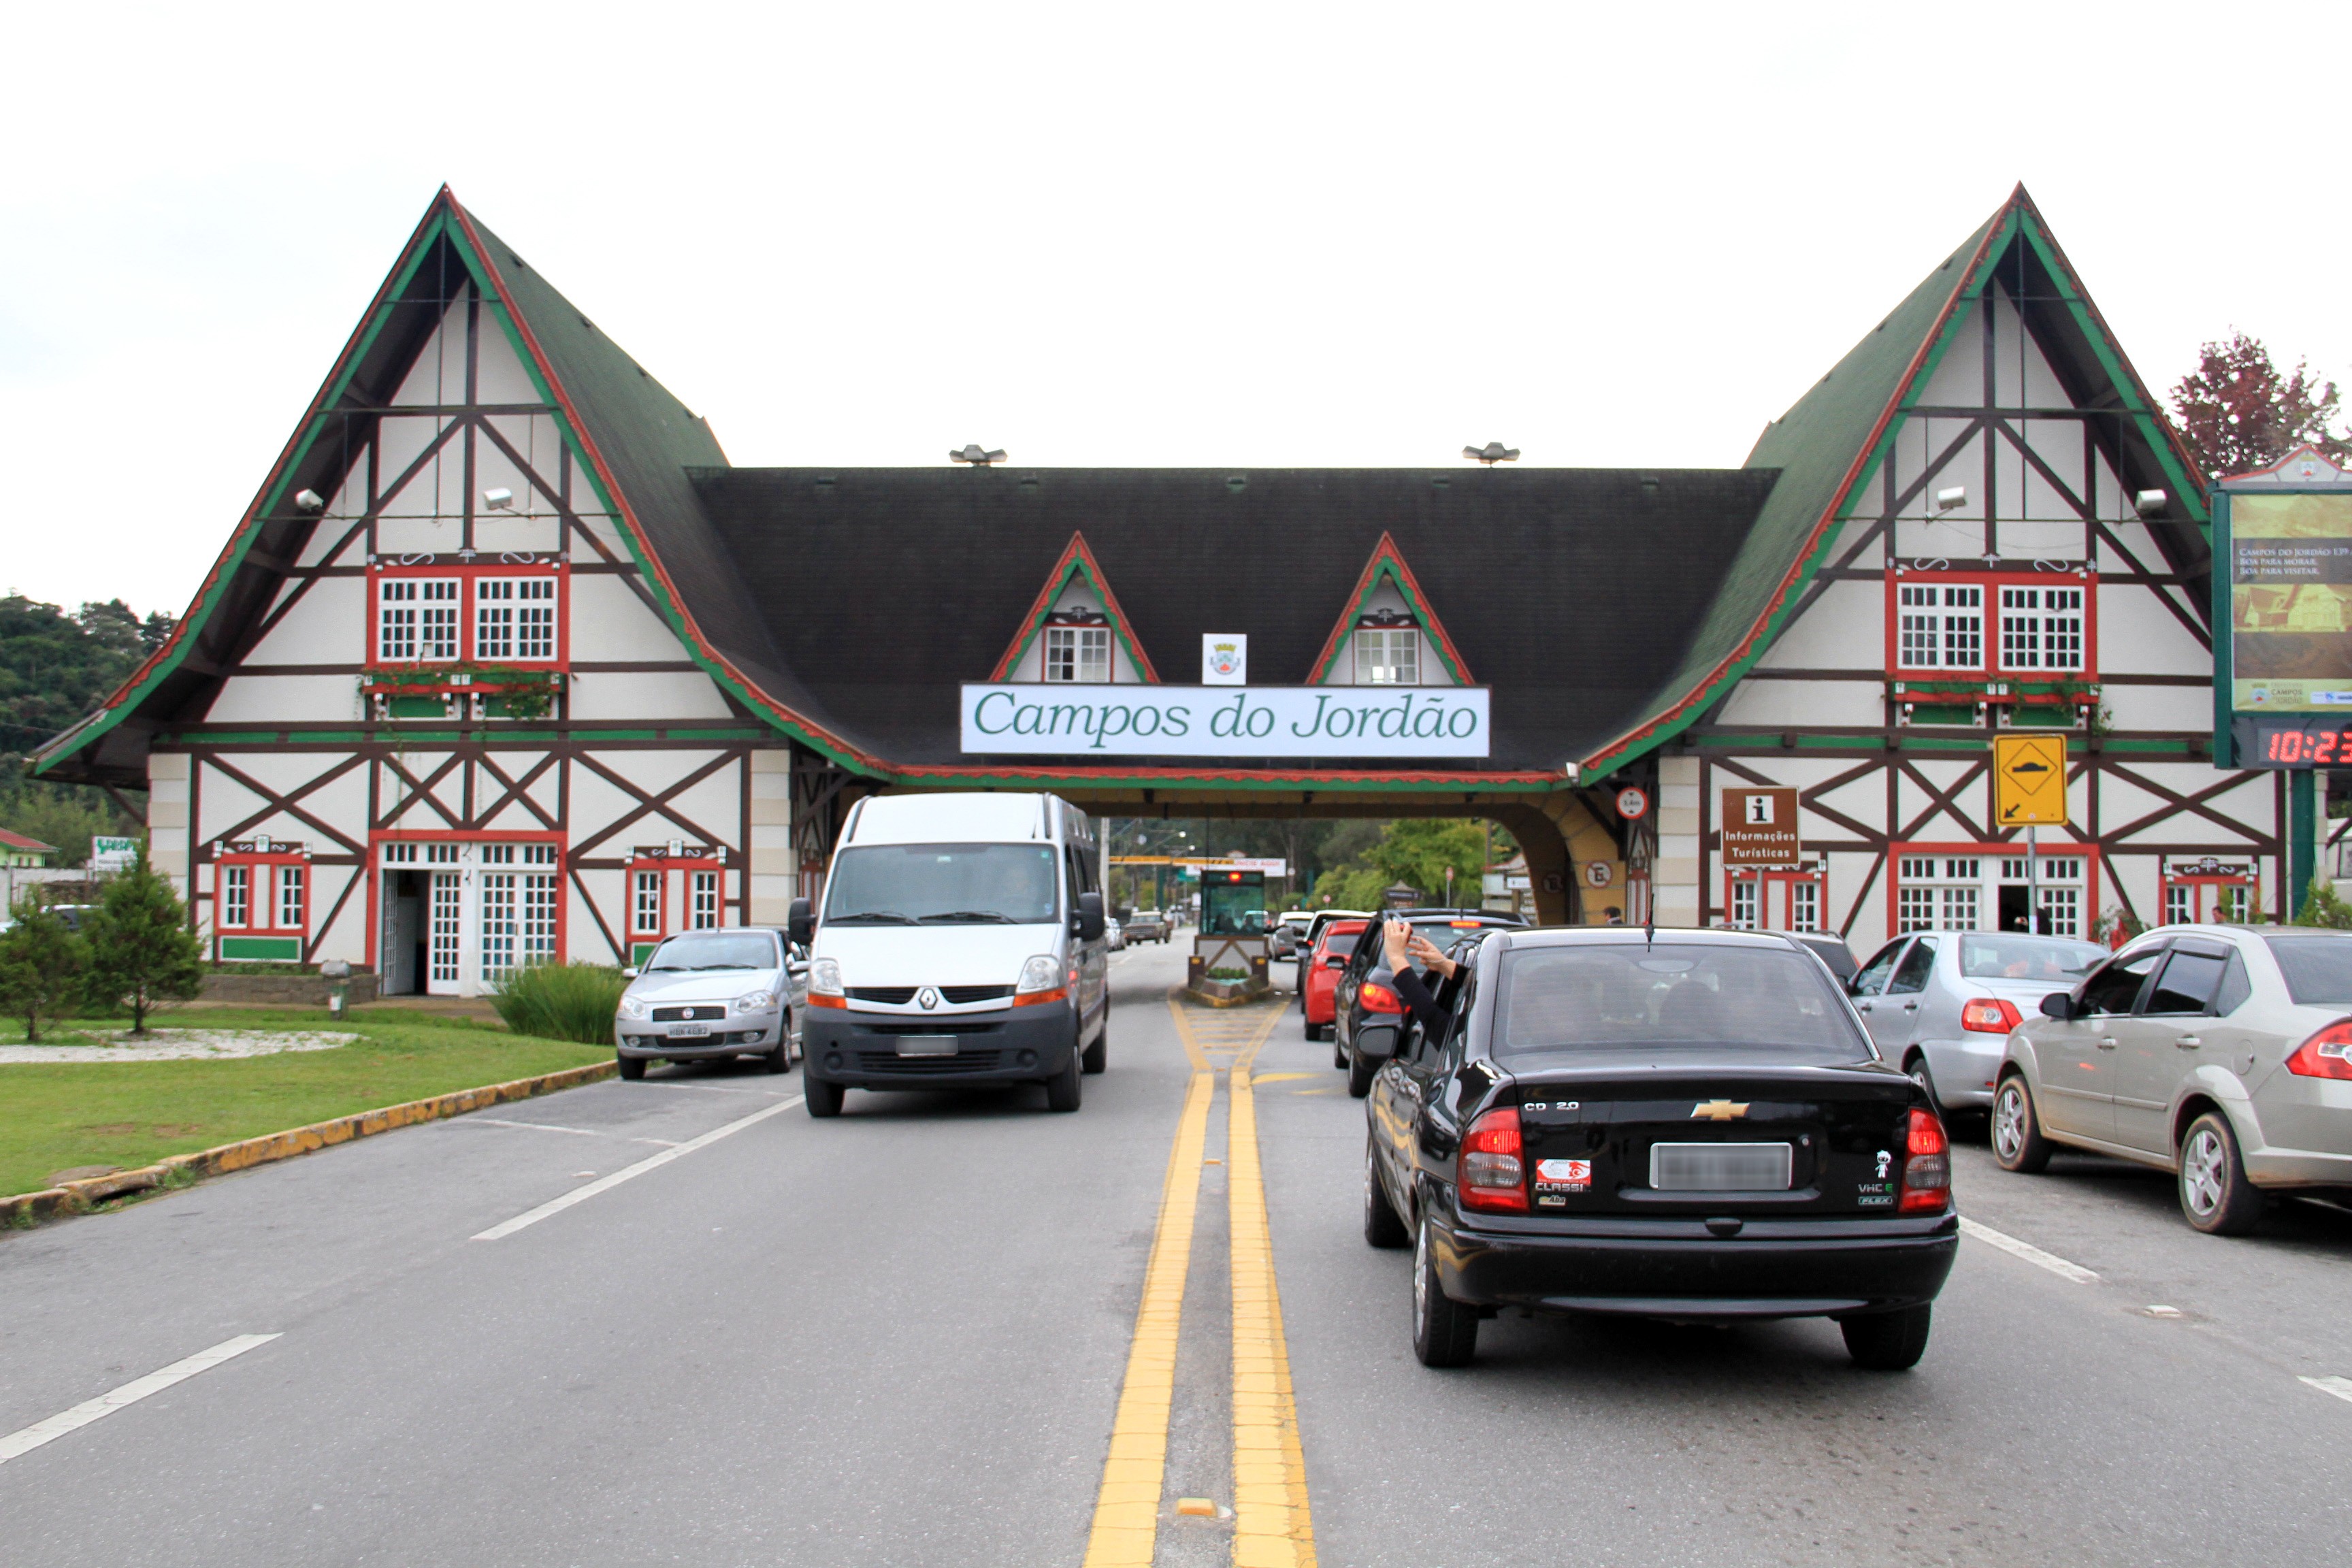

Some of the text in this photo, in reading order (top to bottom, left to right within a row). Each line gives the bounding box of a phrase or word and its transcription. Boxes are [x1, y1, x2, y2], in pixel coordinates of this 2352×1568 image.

[2239, 548, 2276, 556] CAMPOS
[2240, 567, 2258, 575] BOA
[2260, 567, 2283, 575] PARA
[975, 691, 1477, 748] Campos do Jordão
[1725, 830, 1796, 843] Informações
[1731, 847, 1791, 858] Turísticas
[1524, 1101, 1580, 1111] CD 2.0
[1535, 1182, 1591, 1192] CLASSI
[1858, 1183, 1893, 1194] VHC E
[1861, 1196, 1891, 1205] FLEX
